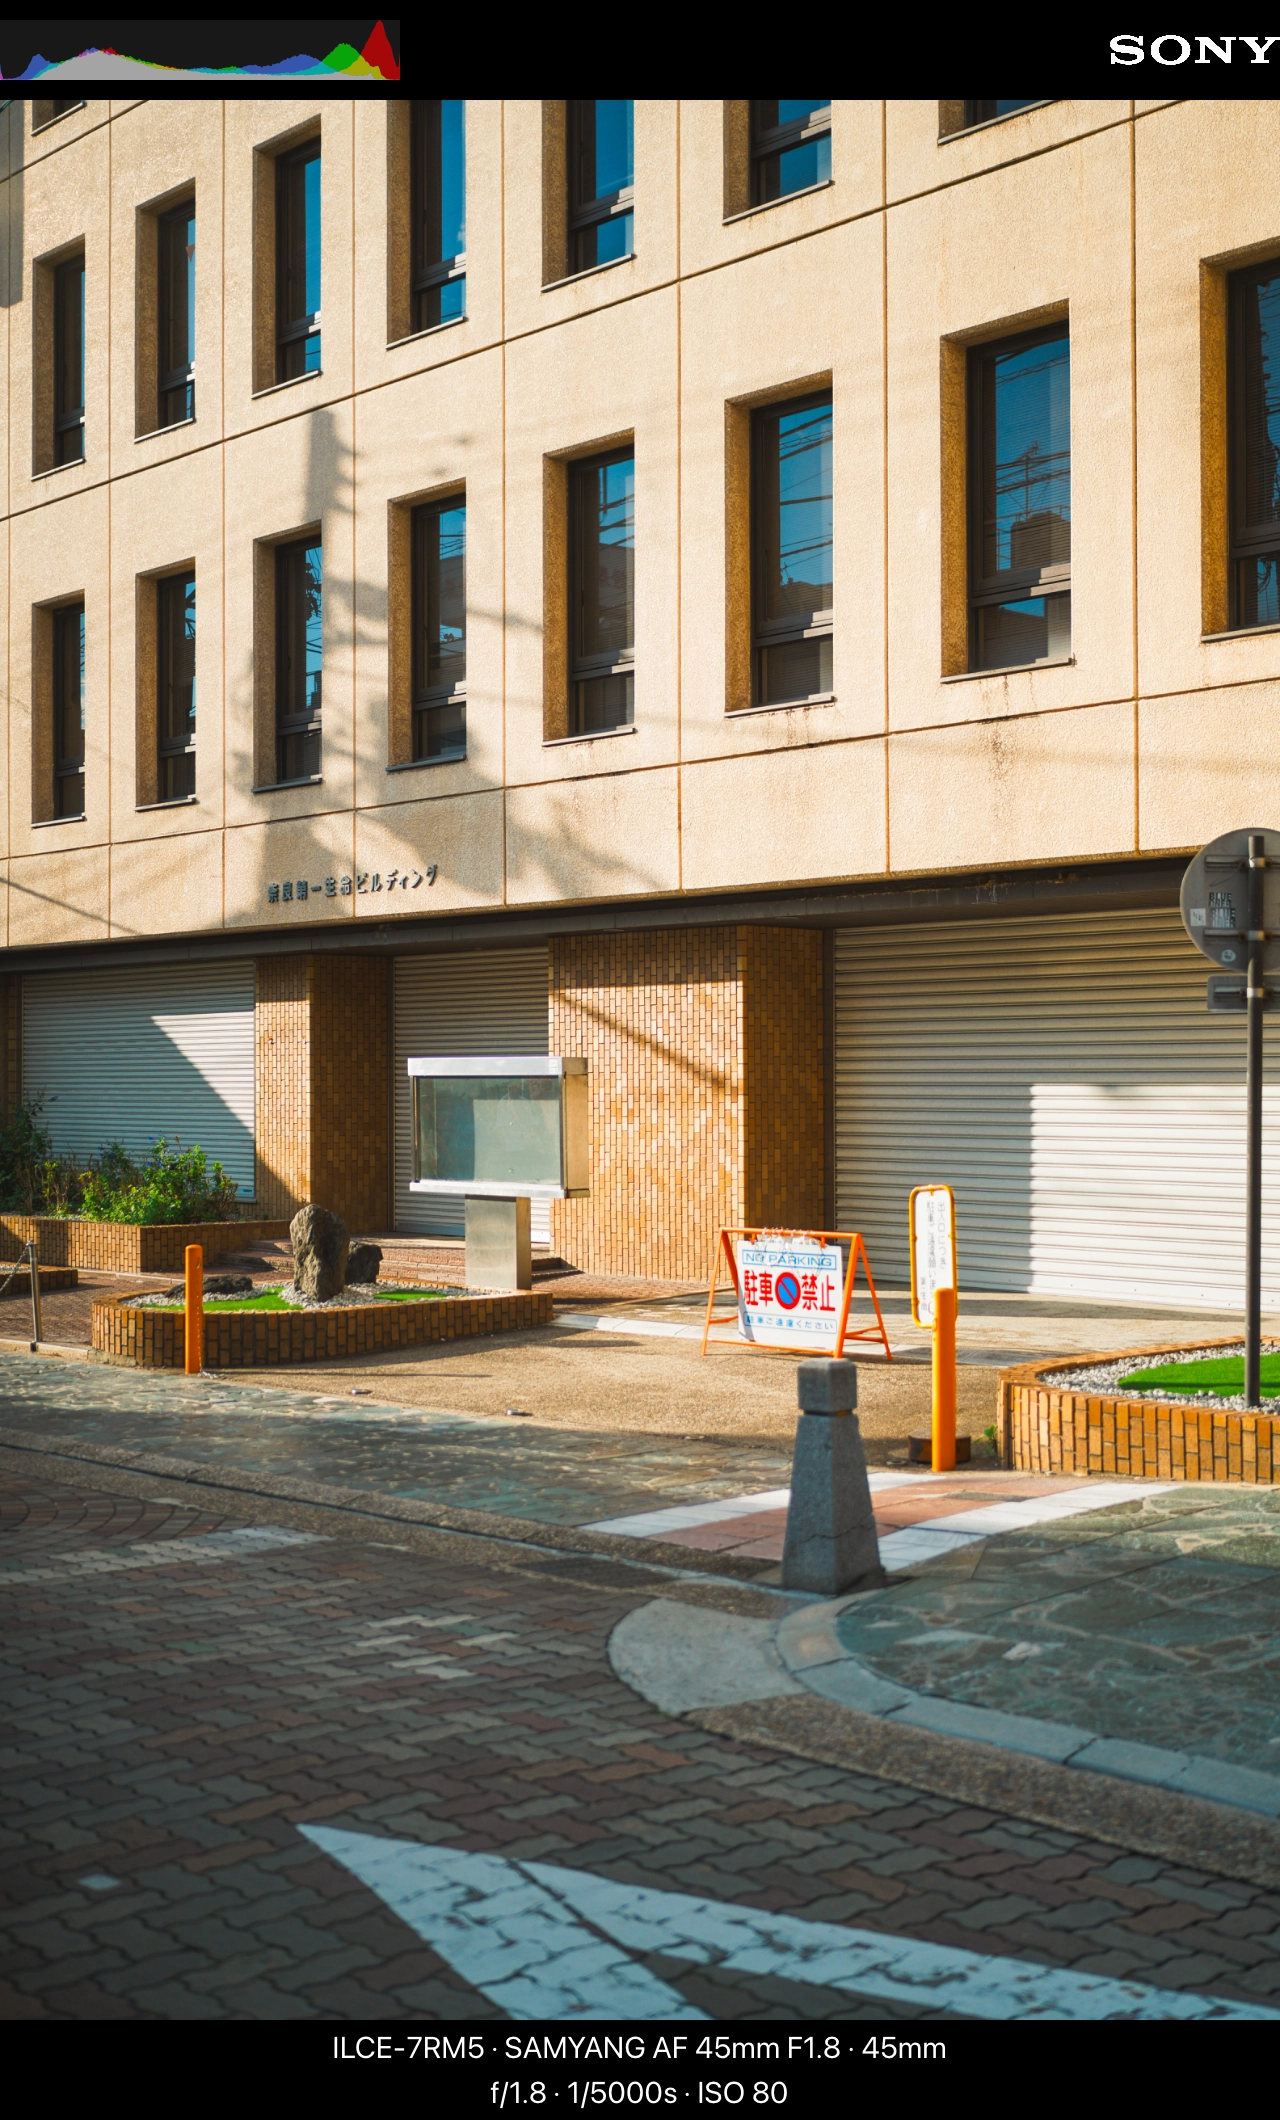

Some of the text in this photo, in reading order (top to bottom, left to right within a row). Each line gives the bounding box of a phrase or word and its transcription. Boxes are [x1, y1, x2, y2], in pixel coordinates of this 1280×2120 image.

[268, 864, 438, 903] 奈良第一生命ビルディング
[1209, 892, 1232, 900] BLUE
[937, 1201, 947, 1270] 出入口につき
[745, 1253, 832, 1267] NO PARKING
[743, 1269, 836, 1312] 駐車 禁止
[745, 1315, 833, 1330] 駐車ご遠慮ください
